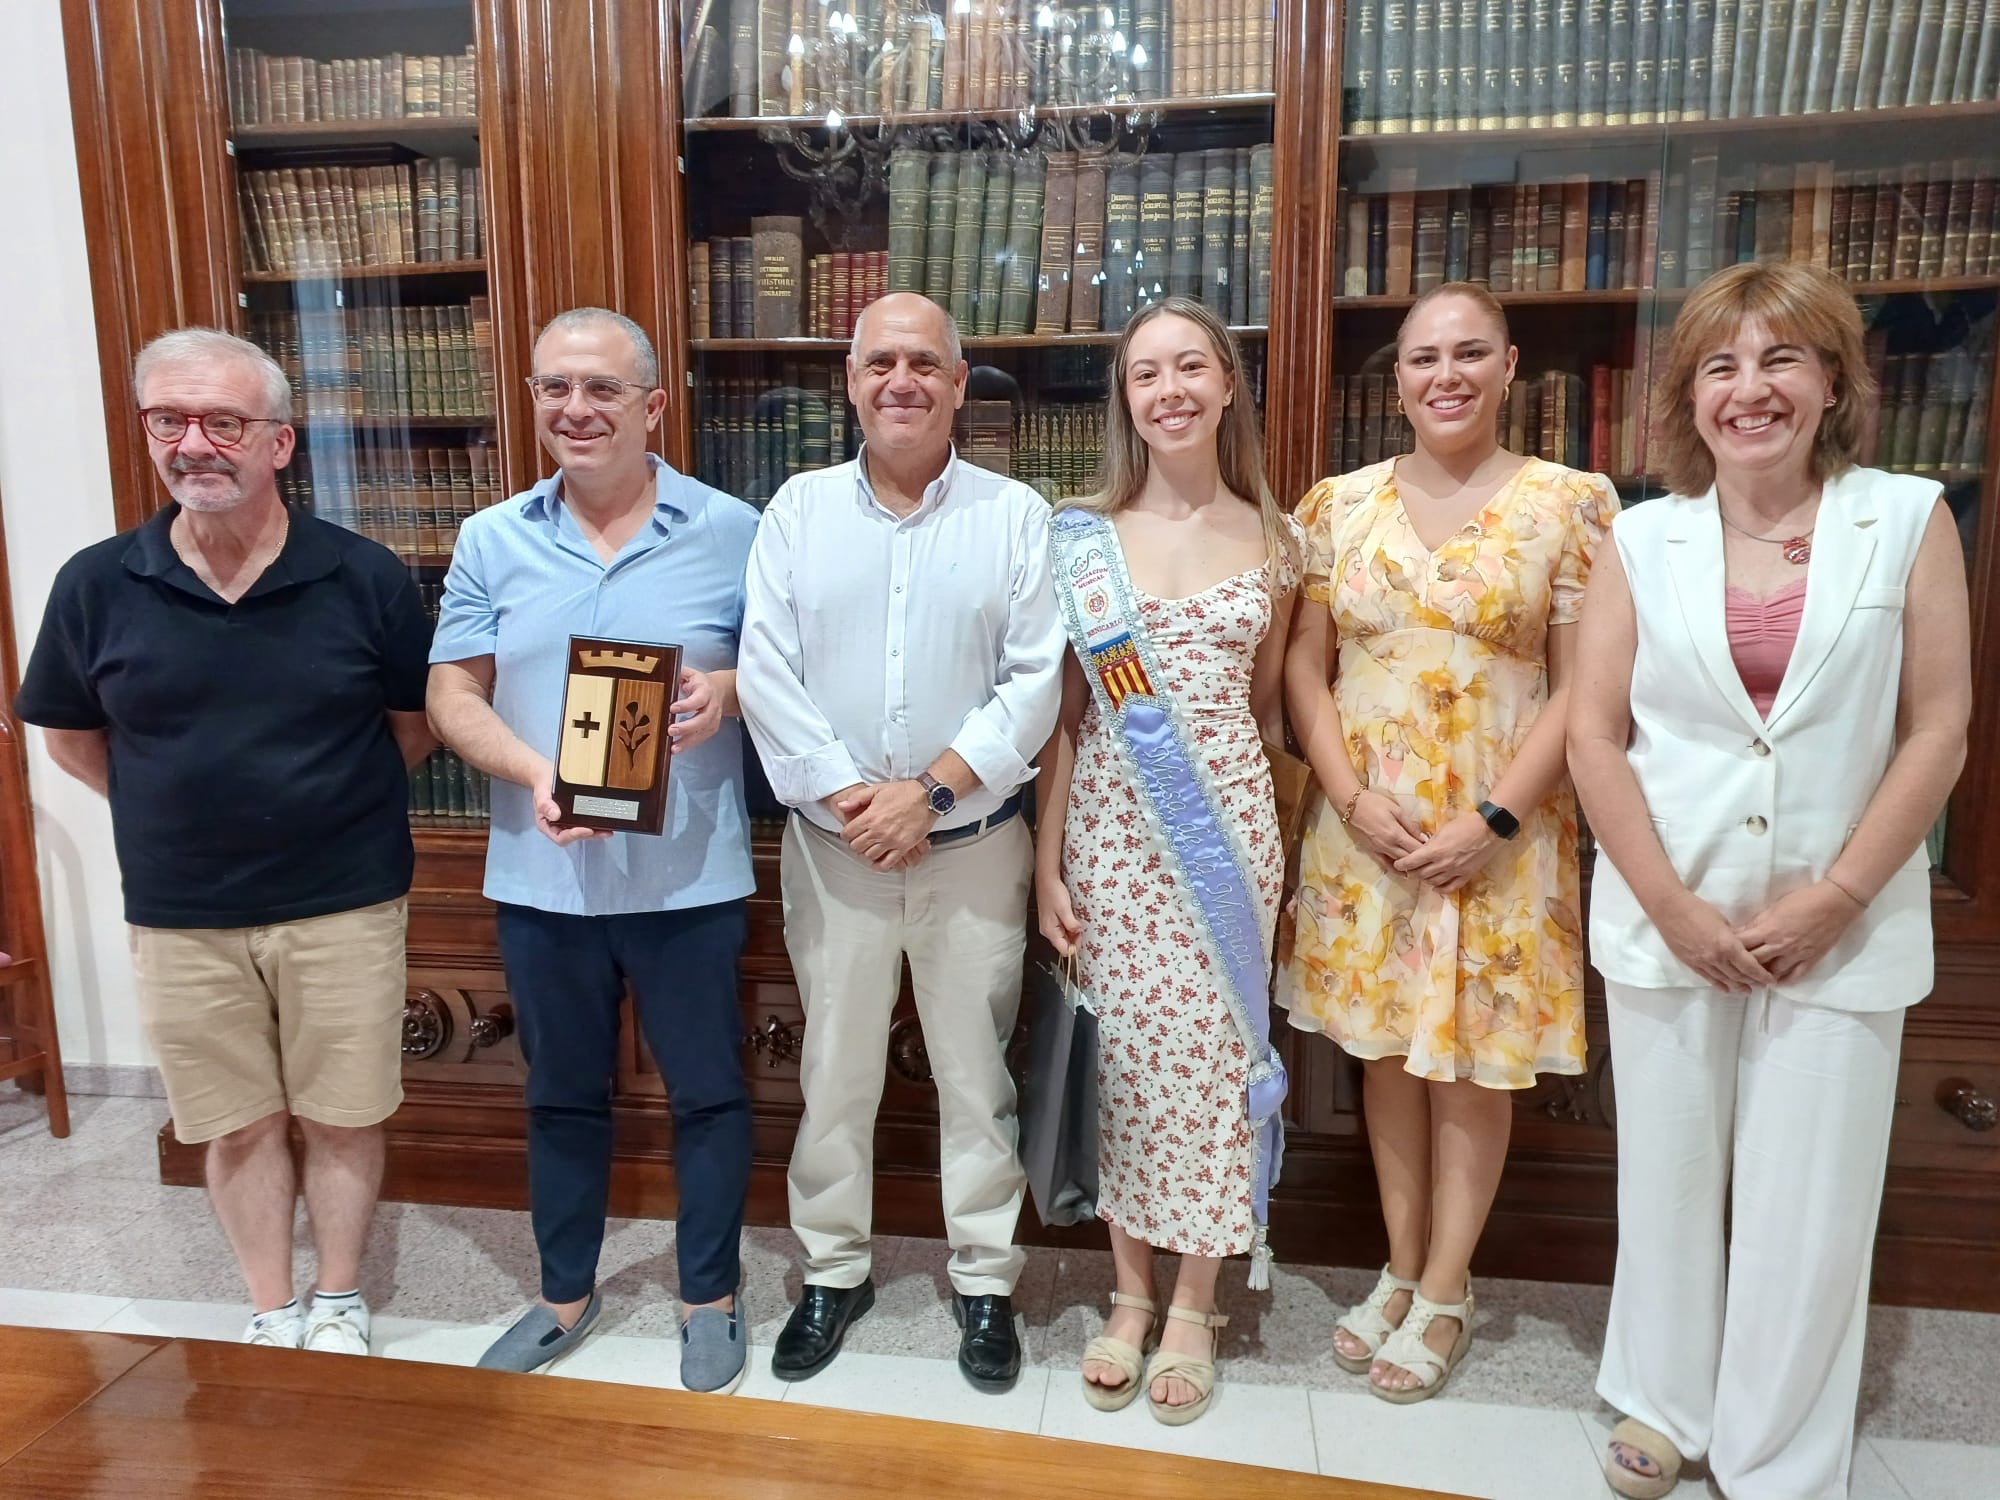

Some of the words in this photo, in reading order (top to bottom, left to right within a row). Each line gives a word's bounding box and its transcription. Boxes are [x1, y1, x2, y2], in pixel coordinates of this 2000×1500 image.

[1078, 574, 1105, 589] MUSICAL
[1144, 747, 1185, 819] Musa
[1177, 823, 1211, 849] de
[1192, 854, 1224, 875] la
